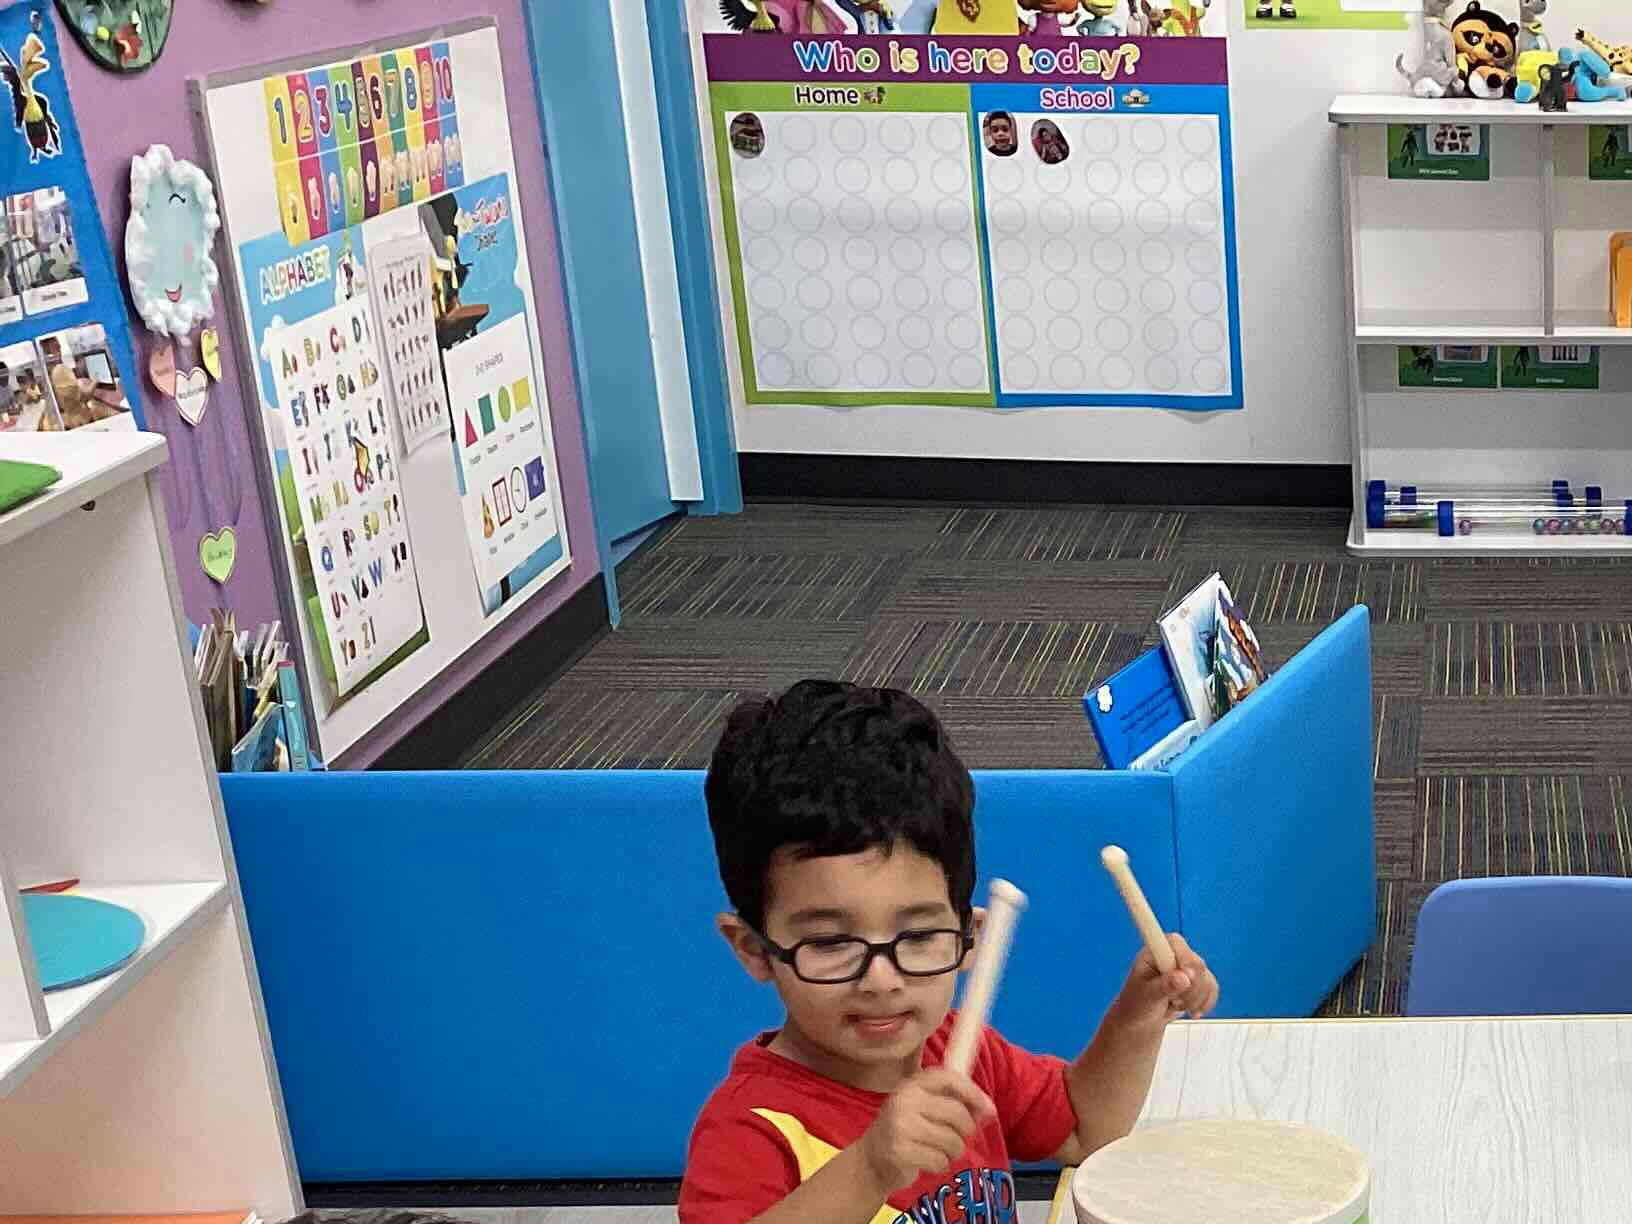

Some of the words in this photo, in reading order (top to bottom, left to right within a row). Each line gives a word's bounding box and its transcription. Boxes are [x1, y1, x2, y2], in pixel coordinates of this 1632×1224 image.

[794, 41, 879, 72] Who
[889, 41, 919, 72] is
[928, 41, 1009, 73] here
[1017, 42, 1141, 80] today?
[274, 96, 287, 144] 1
[294, 90, 314, 142] 2
[314, 85, 333, 137] 3
[334, 80, 353, 132] 4
[370, 74, 383, 120] 6
[384, 68, 401, 118] 7
[404, 66, 418, 111] 8
[433, 56, 453, 101] 10
[793, 85, 859, 105] Home
[1040, 87, 1115, 109] School
[260, 246, 331, 304] ALPHABET
